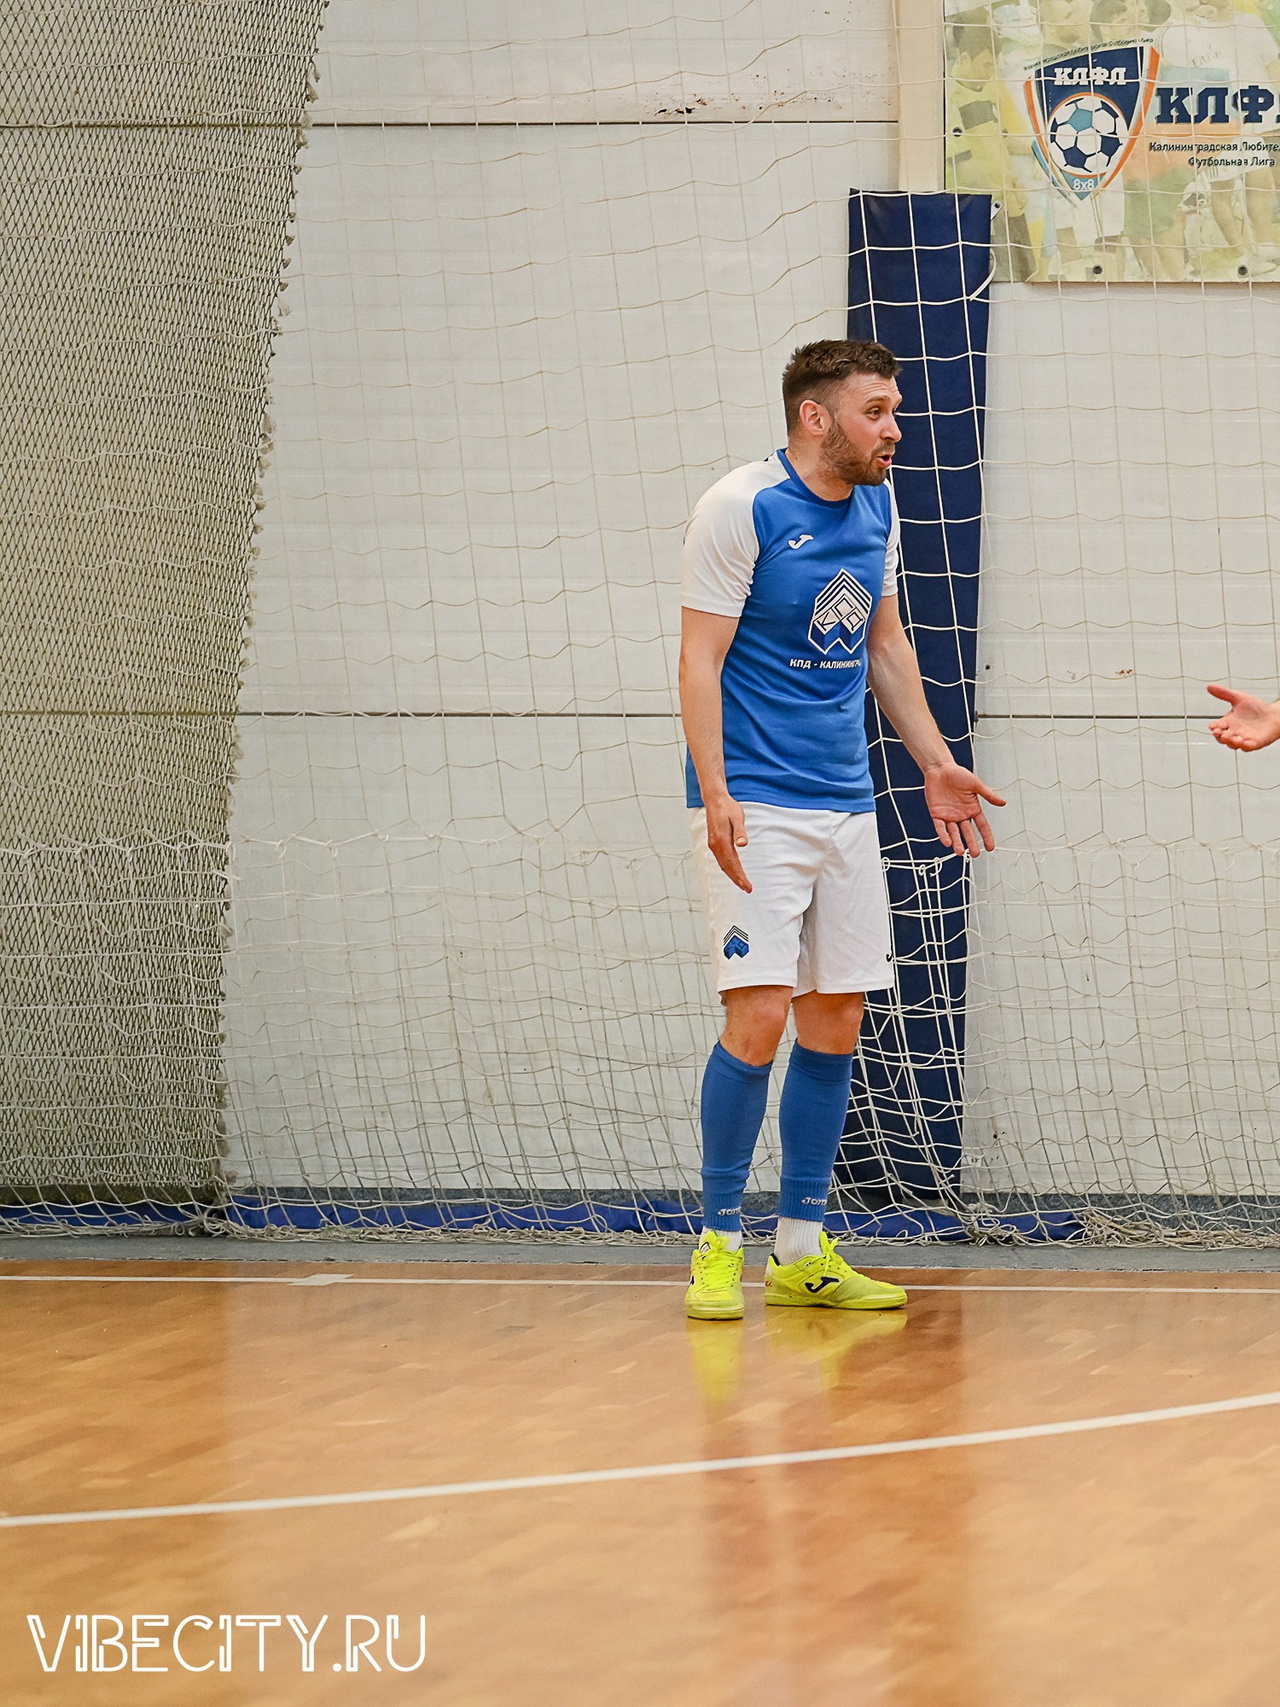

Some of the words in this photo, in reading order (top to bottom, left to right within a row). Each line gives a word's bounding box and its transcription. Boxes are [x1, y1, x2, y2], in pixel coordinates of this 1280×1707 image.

[1054, 66, 1127, 86] КЛФЛ
[1149, 141, 1238, 153] Калининрадская
[1250, 156, 1275, 168] Лига
[789, 658, 812, 670] КПД
